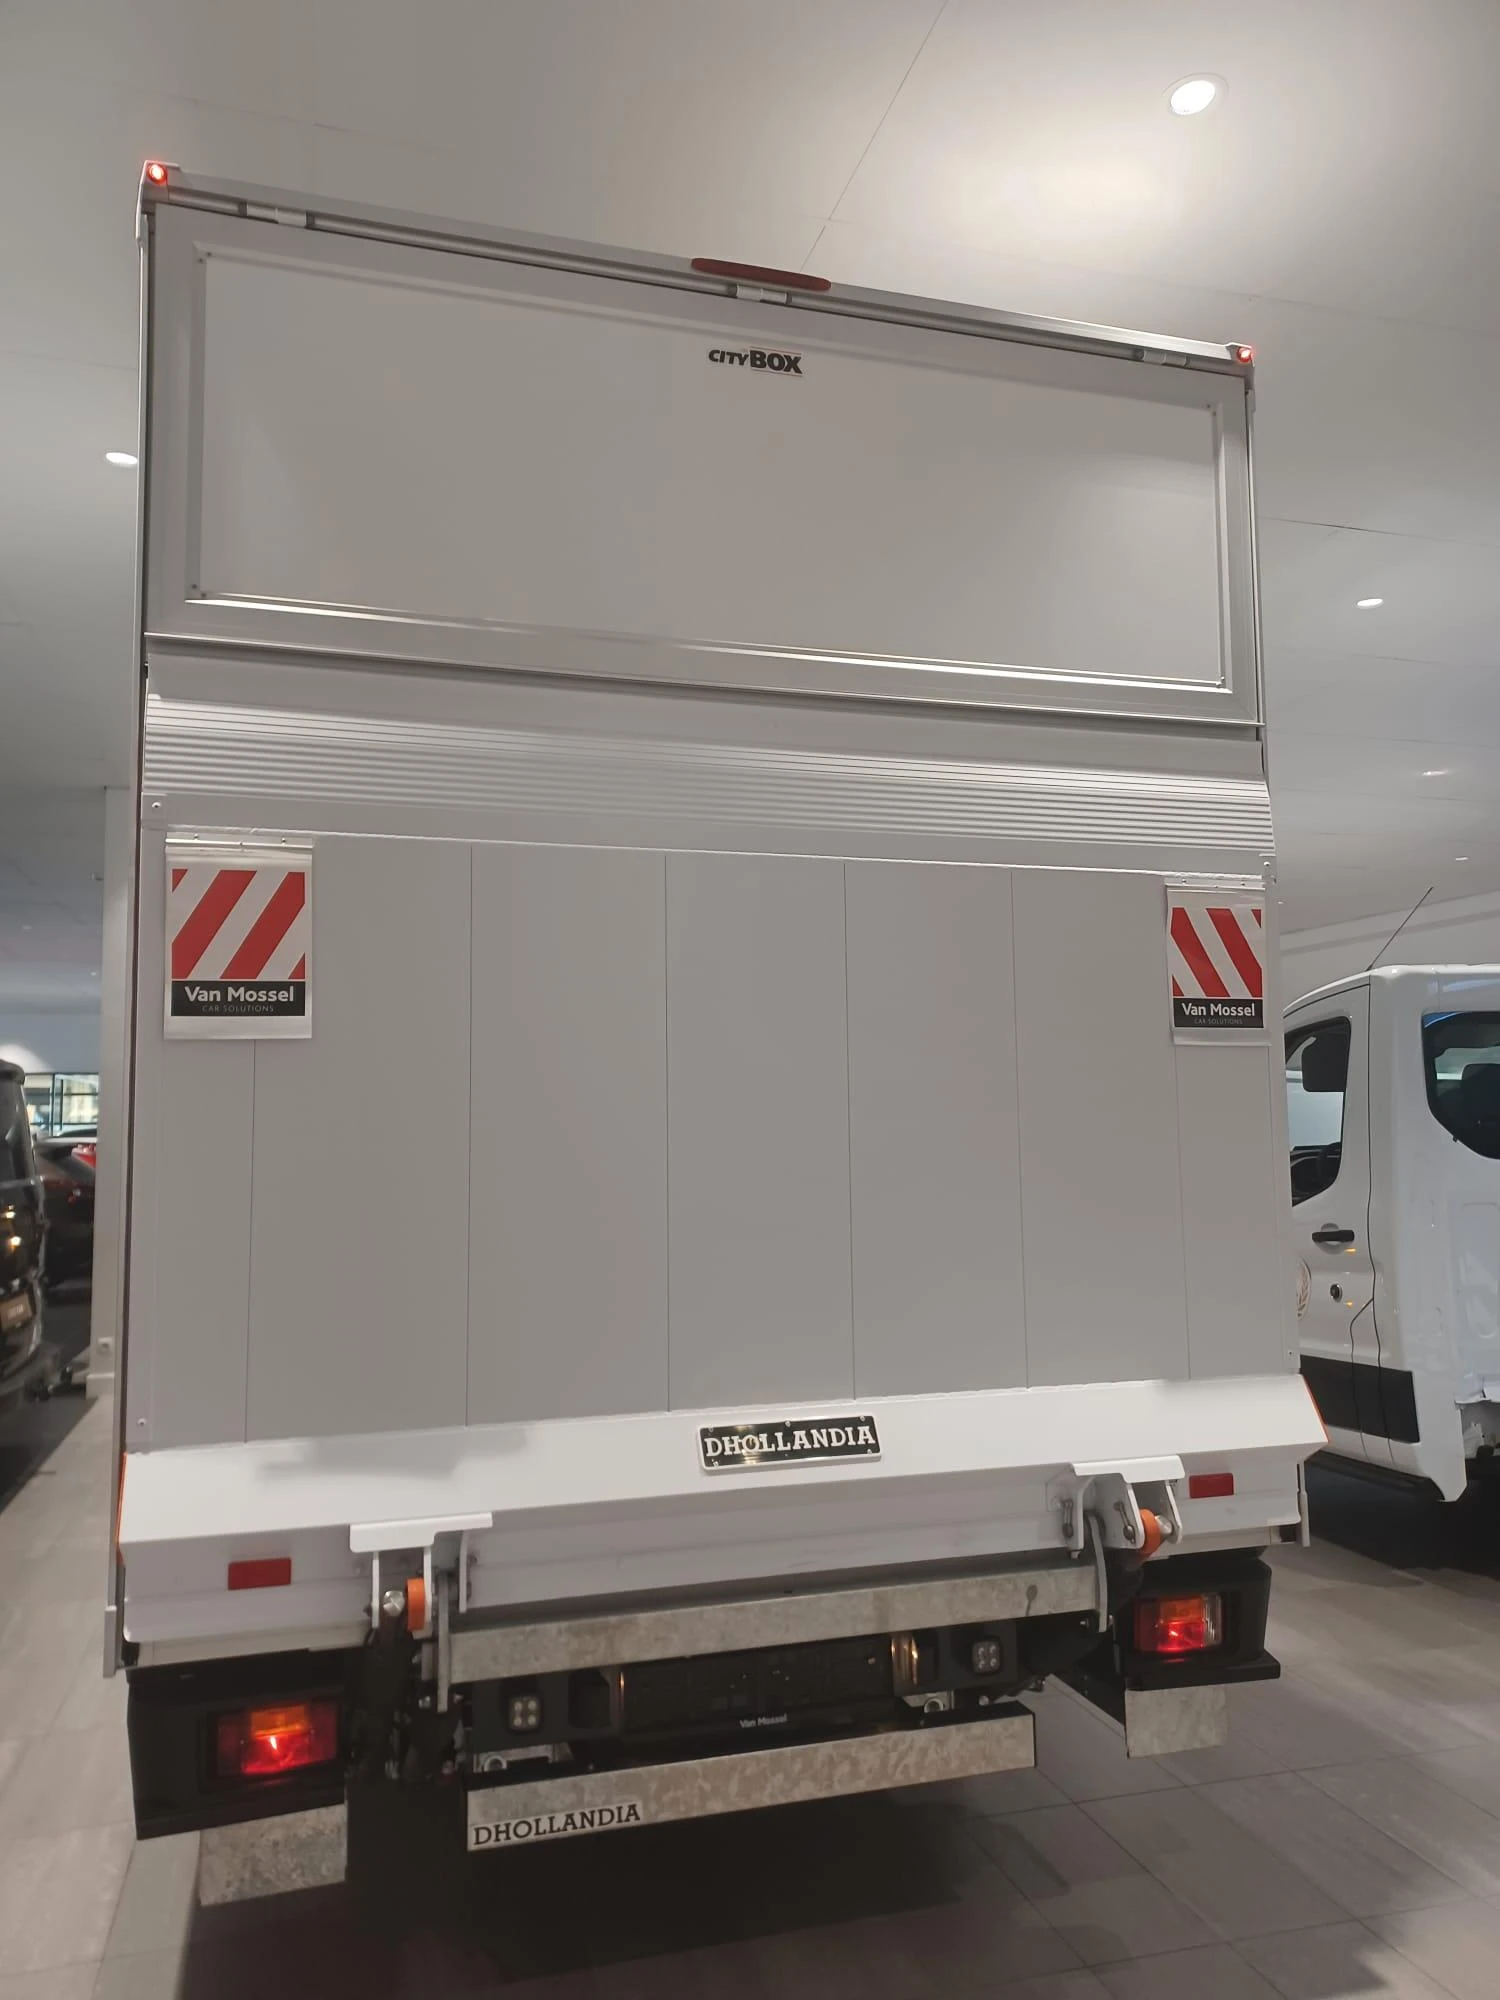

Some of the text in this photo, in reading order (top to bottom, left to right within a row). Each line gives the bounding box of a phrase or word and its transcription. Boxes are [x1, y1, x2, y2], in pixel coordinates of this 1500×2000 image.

[185, 986, 294, 1002] Van Mossel
[202, 1004, 274, 1013] CAR SOLUTIONS
[1182, 1003, 1256, 1017] Van Mossel
[704, 1425, 876, 1457] DHOLLANDIA
[473, 1803, 641, 1845] DHOLLANDIA
